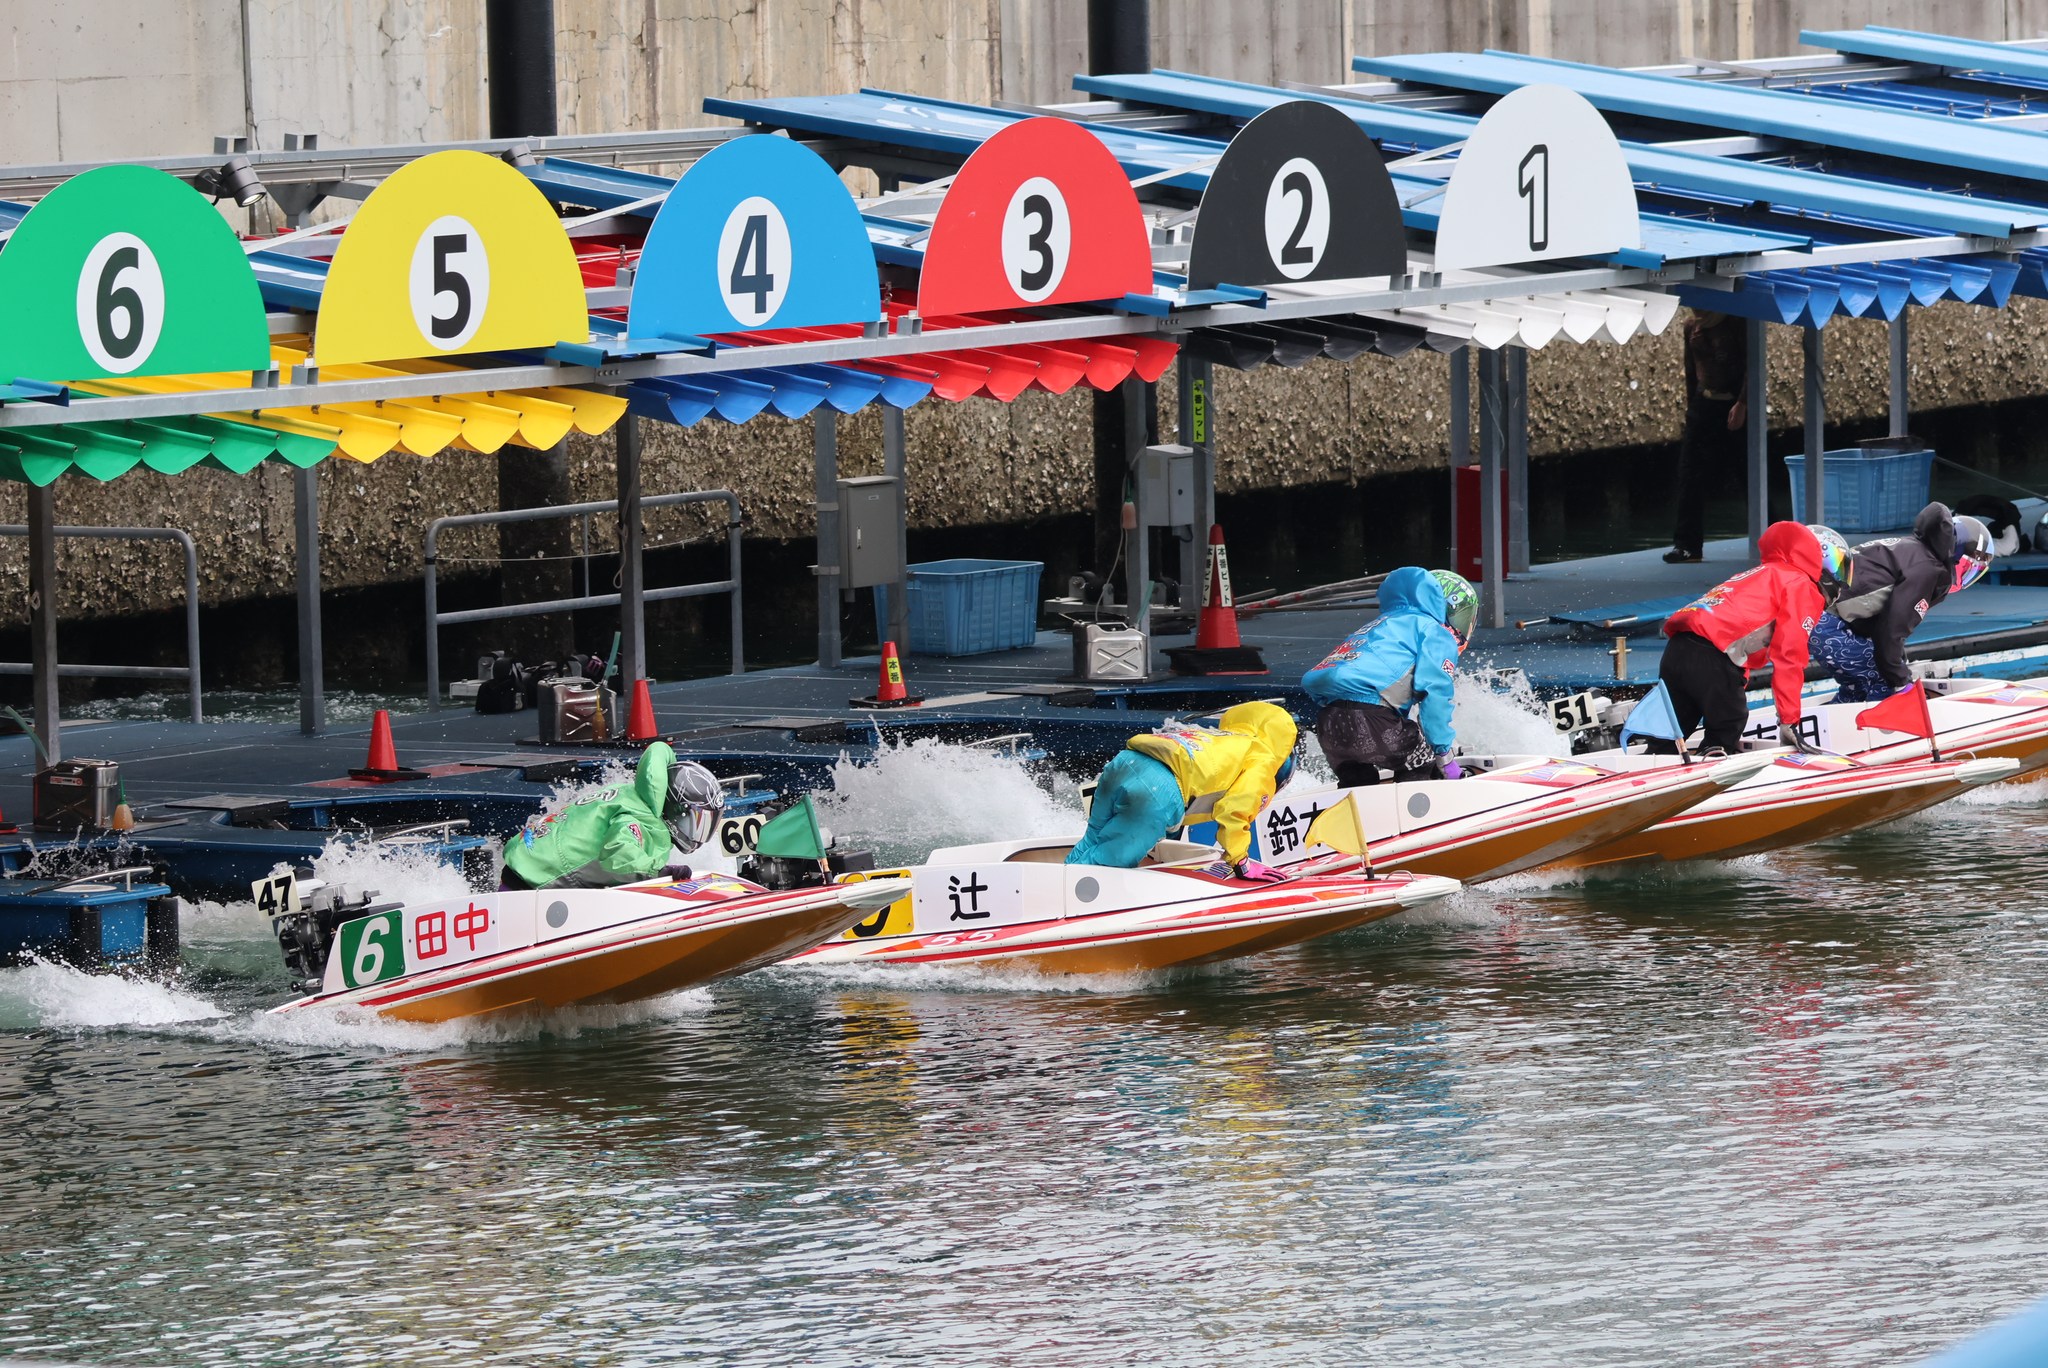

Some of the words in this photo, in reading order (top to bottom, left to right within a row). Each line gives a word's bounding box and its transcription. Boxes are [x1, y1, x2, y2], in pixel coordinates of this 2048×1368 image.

[1281, 172, 1314, 265] 2
[1518, 144, 1549, 252] 1
[730, 214, 774, 314] 4
[1020, 194, 1054, 291] 3
[96, 246, 144, 359] 6
[431, 233, 471, 339] 5
[1217, 547, 1230, 604] 本番ピット
[888, 660, 900, 682] 本番
[1554, 695, 1592, 731] 51
[721, 818, 762, 854] 60
[258, 875, 292, 916] 47
[948, 871, 990, 921] 辻
[352, 916, 390, 986] 6
[415, 902, 489, 960] 田中
[922, 928, 1002, 948] 55
